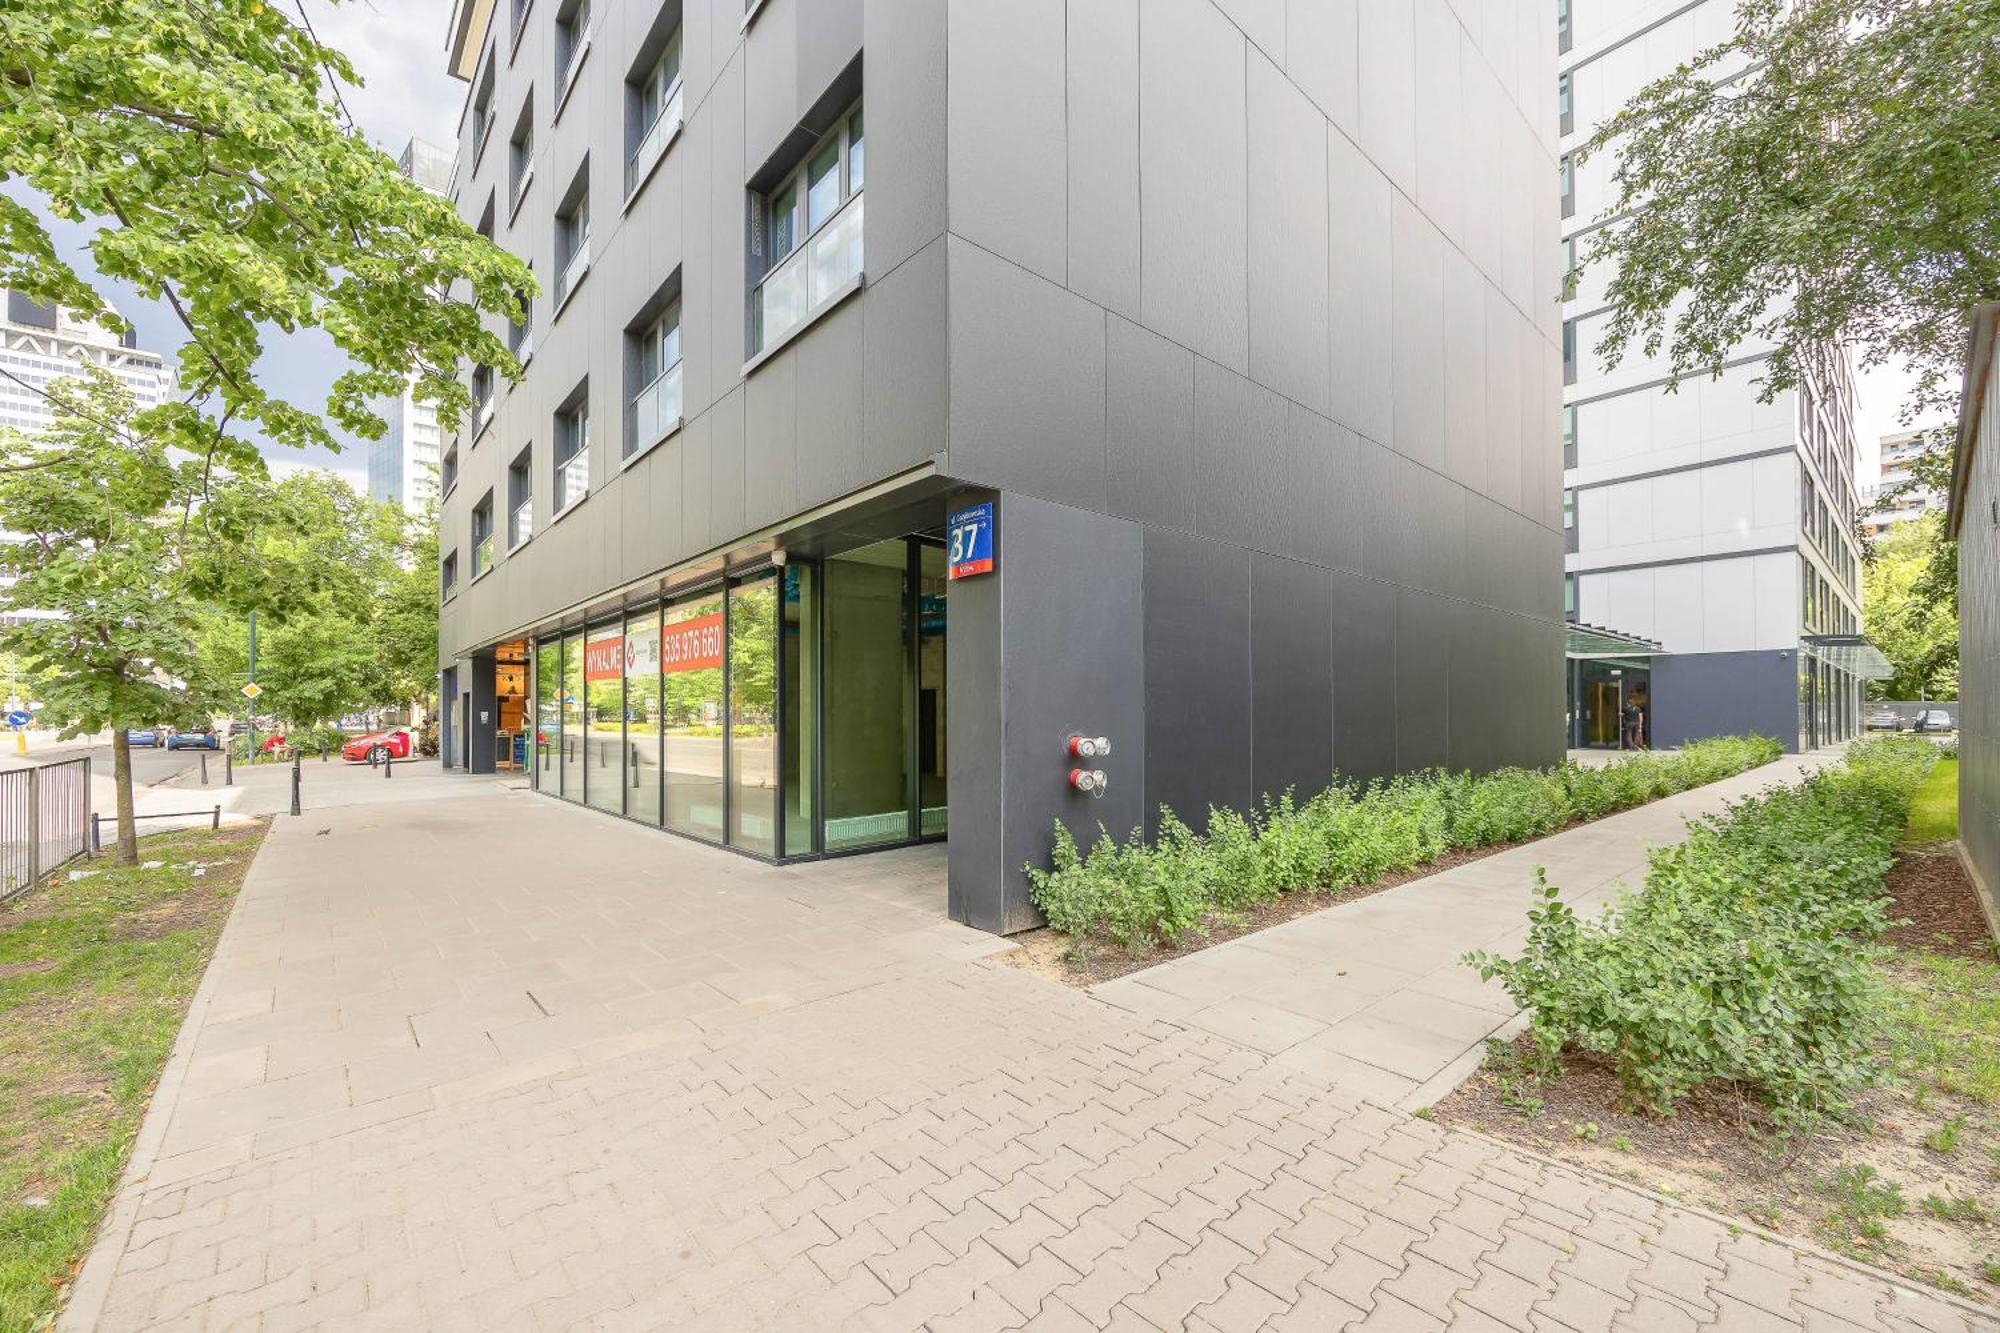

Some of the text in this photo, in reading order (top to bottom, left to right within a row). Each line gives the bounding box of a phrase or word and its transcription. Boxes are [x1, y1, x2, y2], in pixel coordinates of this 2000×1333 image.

[951, 524, 978, 562] 37
[682, 629, 699, 660] 976
[702, 625, 720, 657] 660
